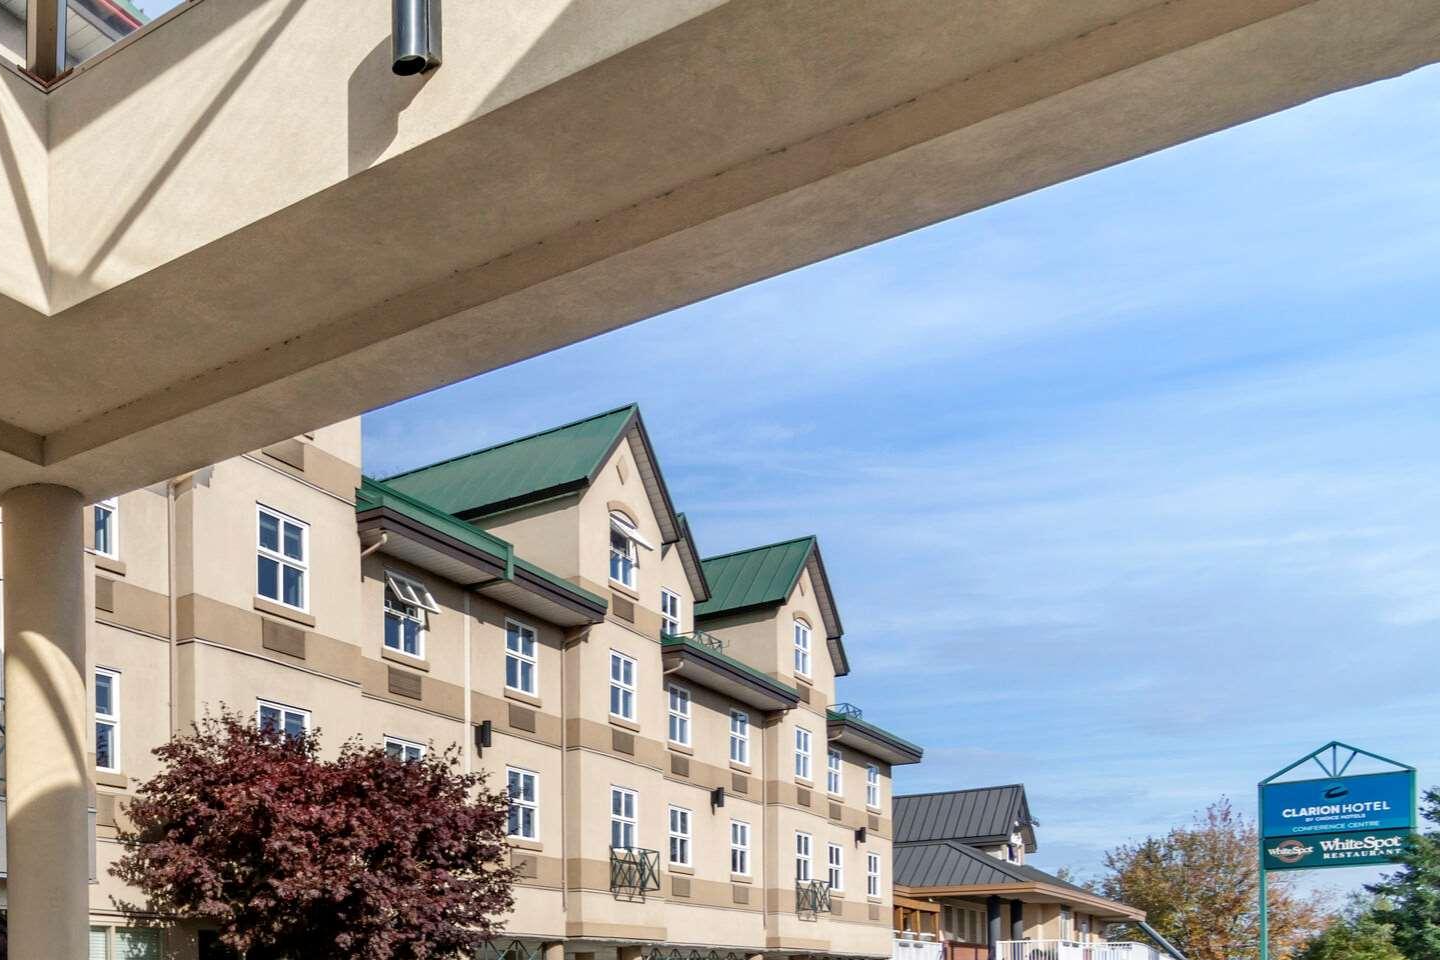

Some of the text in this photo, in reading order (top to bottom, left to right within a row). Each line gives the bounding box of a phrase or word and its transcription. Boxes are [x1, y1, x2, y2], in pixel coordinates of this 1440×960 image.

[1282, 801, 1391, 818] CLARION HOTEL
[1292, 820, 1380, 833] CONFERENCE CENTRE
[1323, 848, 1402, 860] RESTAURANT
